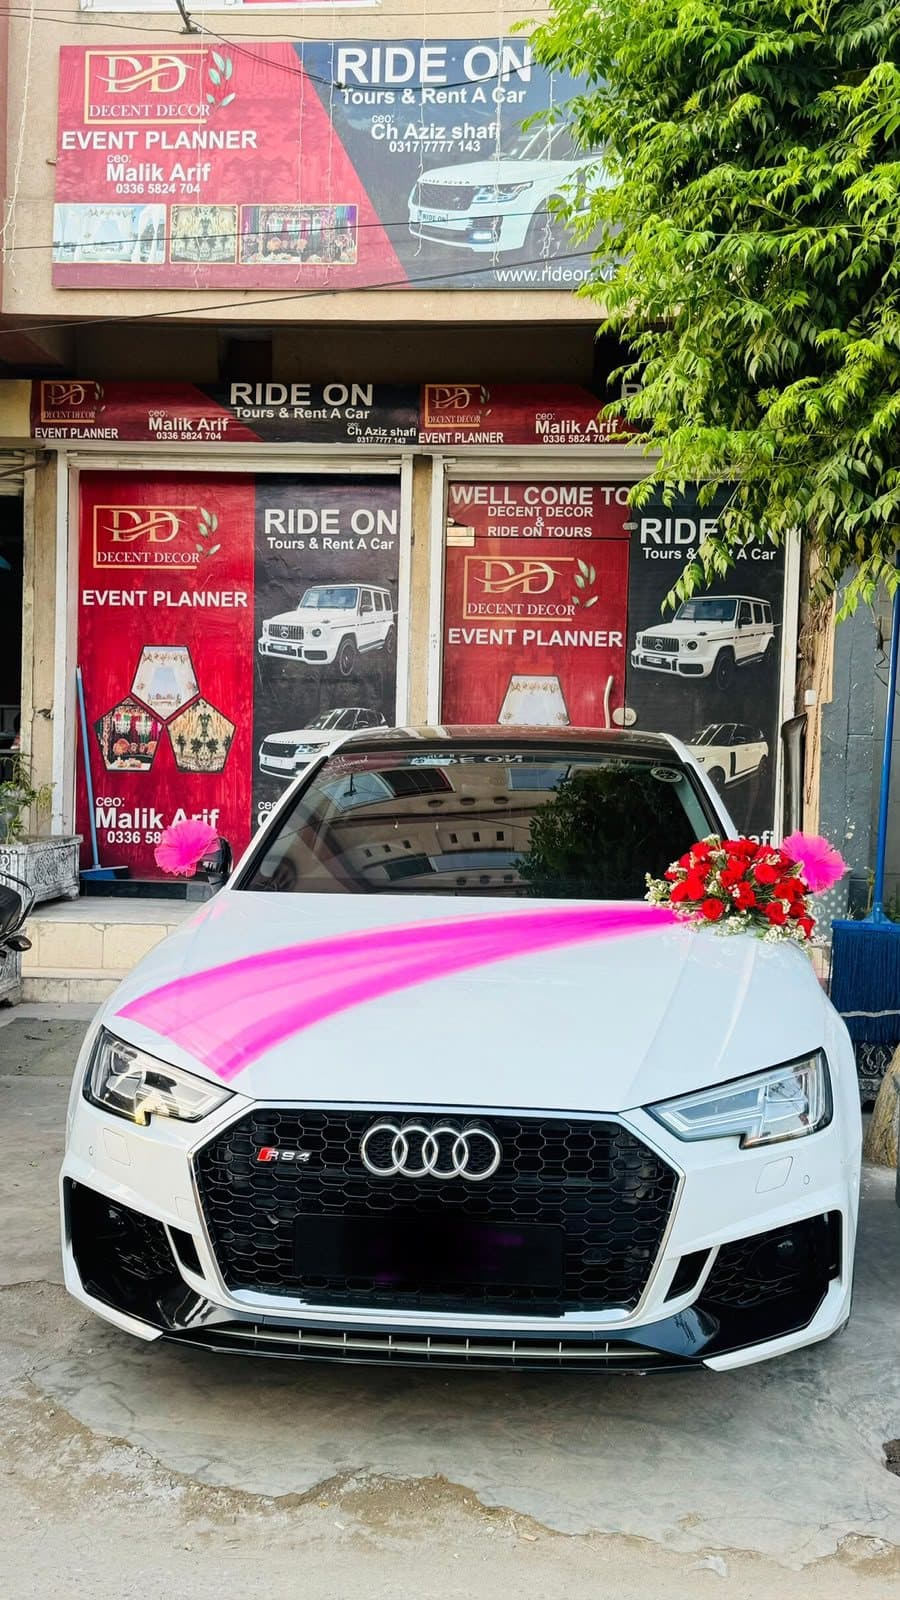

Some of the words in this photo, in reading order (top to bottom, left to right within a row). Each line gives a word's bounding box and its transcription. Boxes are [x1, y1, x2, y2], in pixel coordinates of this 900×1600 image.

[338, 47, 448, 84] RIDE
[463, 46, 532, 82] ON
[341, 88, 395, 104] Tours
[402, 88, 415, 105] &
[422, 87, 467, 104] Rent
[471, 88, 486, 103] A
[492, 86, 526, 103] Car
[90, 104, 152, 117] DECENT
[157, 103, 210, 117] DECOR
[372, 114, 394, 124] ceo:
[371, 124, 398, 140] Ch
[403, 124, 446, 140] Aziz
[451, 122, 500, 140] shafi
[62, 131, 138, 150] EVENT
[145, 130, 257, 149] PLANNER
[389, 141, 418, 153] 0317
[422, 141, 454, 152] 7777
[458, 140, 481, 152] 143
[107, 154, 132, 164] ceo:
[106, 164, 163, 182] Malik
[169, 163, 211, 182] Arif
[115, 184, 145, 194] 0336
[147, 183, 176, 194] 5824
[179, 183, 201, 194] 704
[230, 382, 311, 406] RIDE
[323, 383, 373, 406] ON
[148, 409, 168, 418] ceo:
[235, 407, 274, 419] Tours
[279, 407, 290, 418] &
[294, 407, 327, 419] Rent
[330, 408, 342, 419] A
[345, 408, 371, 419] Car
[535, 412, 556, 421] ceo:
[148, 418, 193, 431] Malik
[198, 418, 229, 431] Arif
[535, 419, 580, 434] Malik
[586, 420, 618, 433] Arif
[35, 427, 68, 438] EVENT
[70, 427, 119, 439] PLANNER
[156, 432, 178, 440] 0336
[181, 432, 203, 440] 5824
[205, 432, 222, 440] 704
[346, 426, 362, 436] Ch
[365, 426, 388, 436] Aziz
[390, 427, 417, 437] shafi
[418, 432, 452, 444] EVENT
[454, 432, 504, 443] PLANNER
[542, 435, 565, 443] 0336
[568, 435, 591, 443] 5824
[451, 486, 517, 504] WELL
[523, 486, 593, 505] COME
[600, 486, 630, 506] TO
[487, 506, 542, 517] DECENT
[545, 506, 594, 518] DECOR
[264, 508, 340, 534] RIDE
[351, 509, 398, 535] ON
[535, 517, 545, 527] &
[487, 526, 519, 537] RIDE
[522, 526, 542, 537] ON
[547, 526, 593, 537] TOURS
[267, 537, 305, 550] Tours
[308, 537, 319, 550] &
[323, 537, 354, 550] Rent
[357, 538, 368, 550] A
[370, 538, 394, 550] Car
[96, 551, 152, 563] DECENT
[153, 552, 201, 563] DECOR
[642, 547, 682, 560] Tours
[686, 547, 697, 560] &
[736, 549, 748, 560] A
[751, 548, 777, 560] Car
[82, 590, 148, 606] EVENT
[153, 591, 248, 607] PLANNER
[467, 603, 525, 615] DECENT
[527, 604, 576, 616] DECOR
[448, 628, 516, 645] EVENT
[522, 629, 623, 647] PLANNER
[95, 796, 125, 807] ceo:
[95, 807, 163, 829] Malik
[107, 831, 141, 844] 0336
[257, 1147, 312, 1161] RS4
